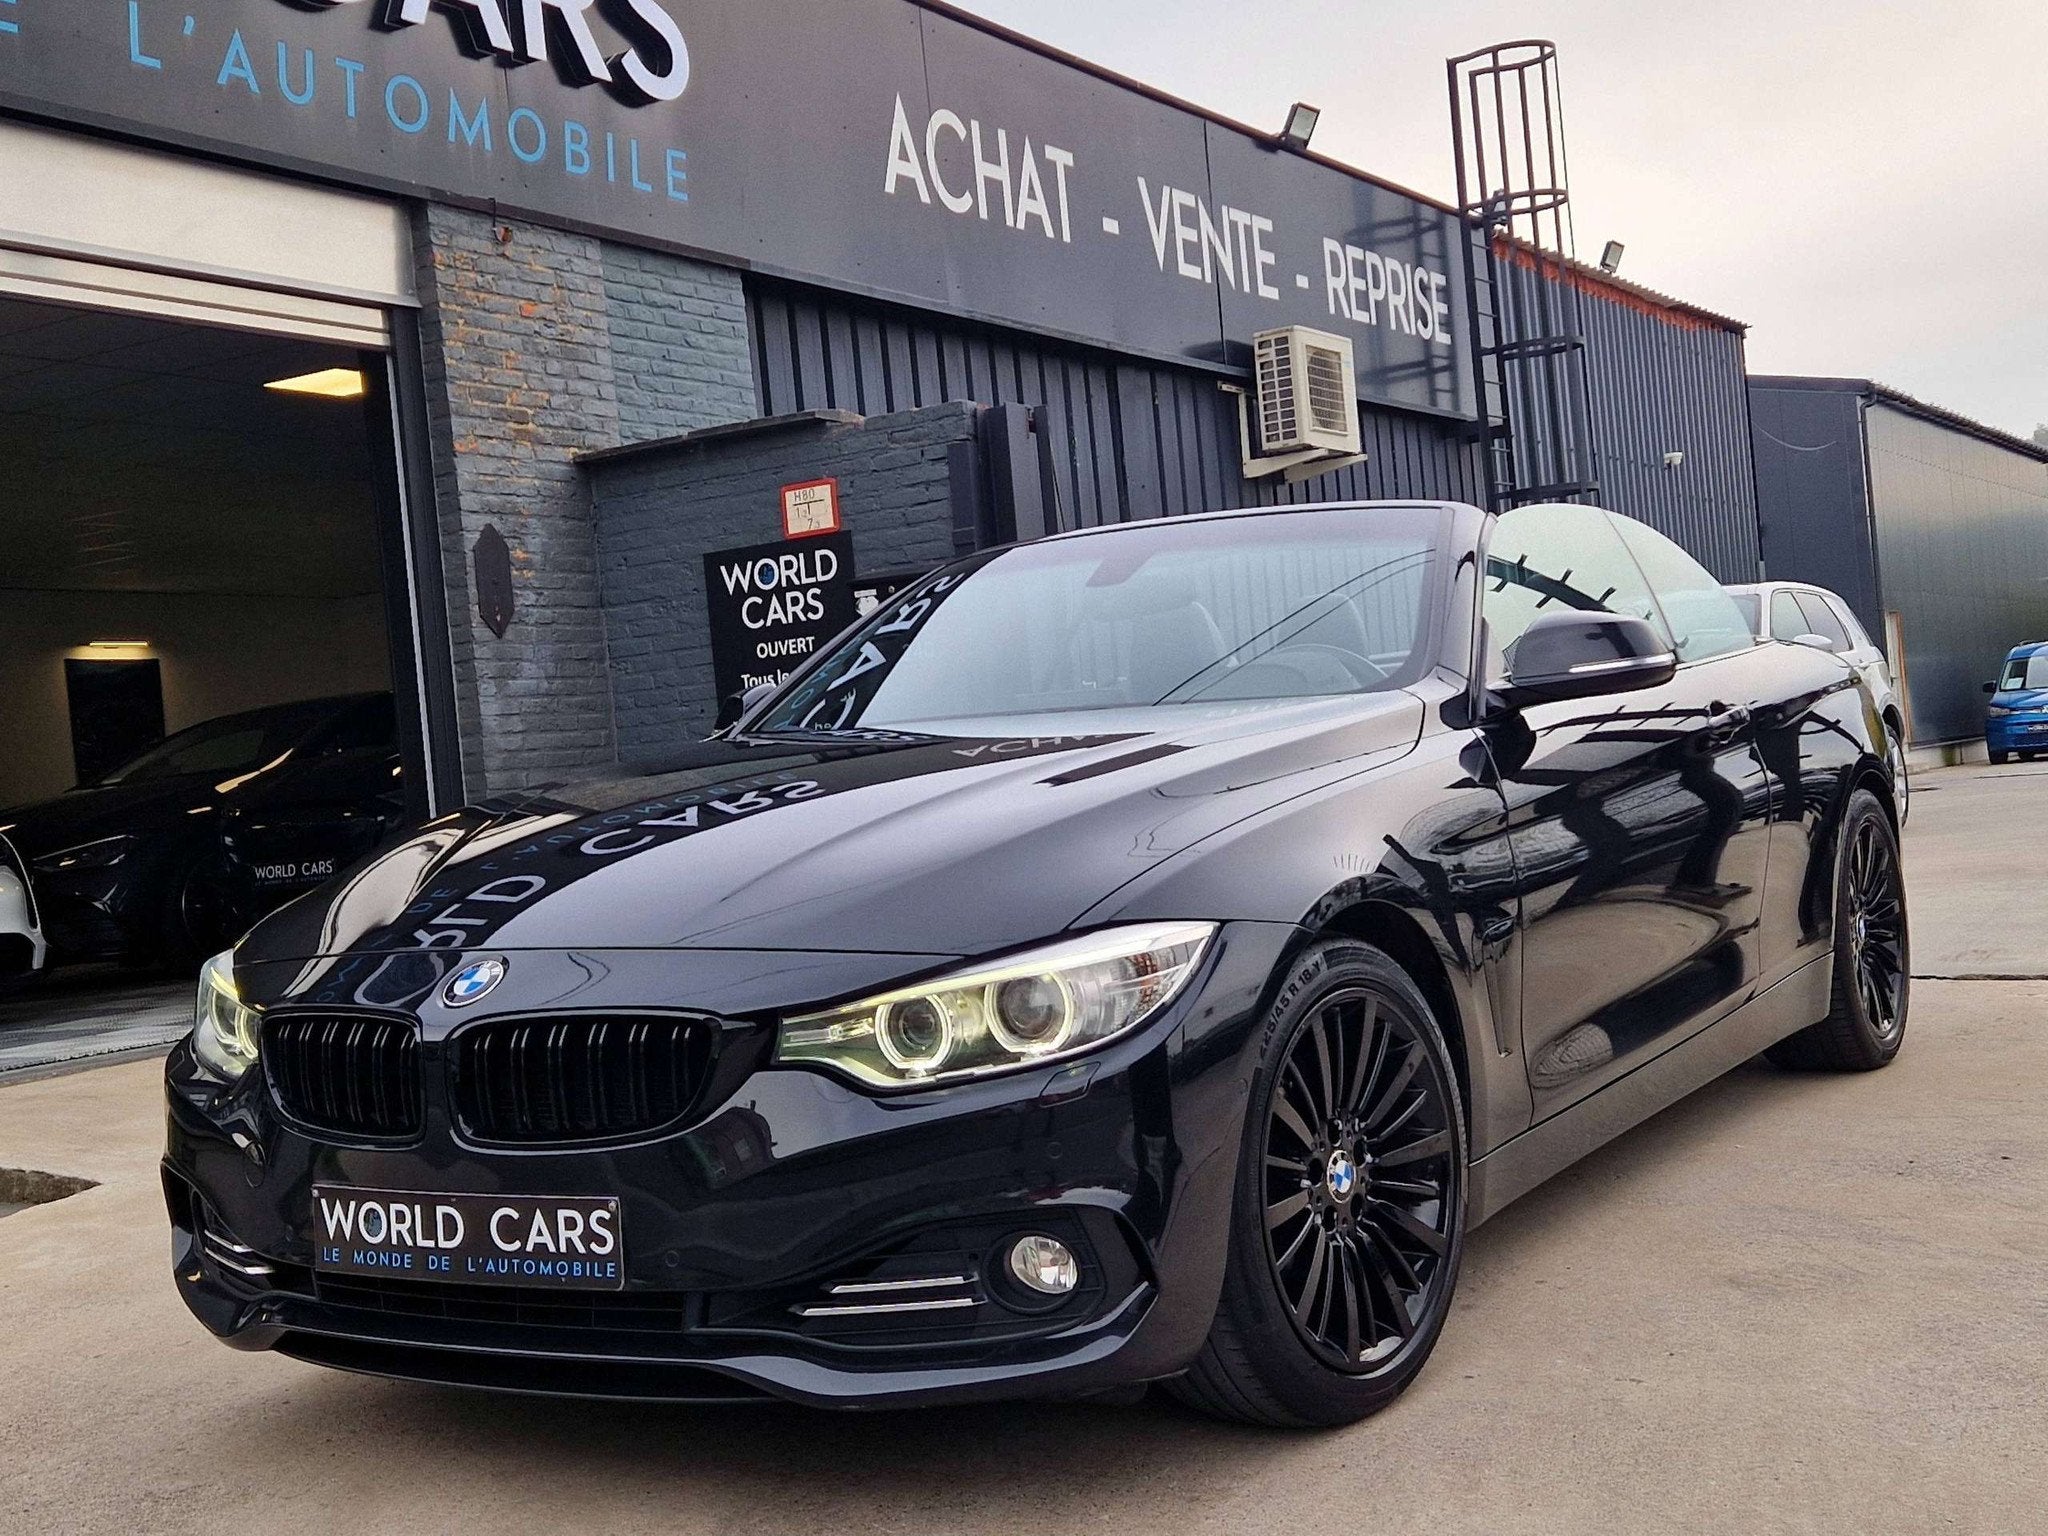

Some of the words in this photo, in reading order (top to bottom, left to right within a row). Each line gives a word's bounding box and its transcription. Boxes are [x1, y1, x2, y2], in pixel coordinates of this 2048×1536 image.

[884, 92, 1074, 243] ACHAT
[1138, 176, 1280, 301] VENTE
[1322, 237, 1452, 345] REPRISE
[720, 549, 838, 596] WORLD
[741, 588, 825, 629] CARS
[756, 636, 816, 659] OUVERT
[741, 673, 775, 689] Tous
[254, 863, 296, 879] WORLD
[301, 860, 333, 876] CARS
[319, 1197, 466, 1250] WORLD
[489, 1206, 616, 1256] CARS
[322, 1246, 341, 1263] LE
[352, 1249, 413, 1269] MONDE
[428, 1255, 451, 1271] DE
[467, 1257, 617, 1279] L'AUTOMOBILE
